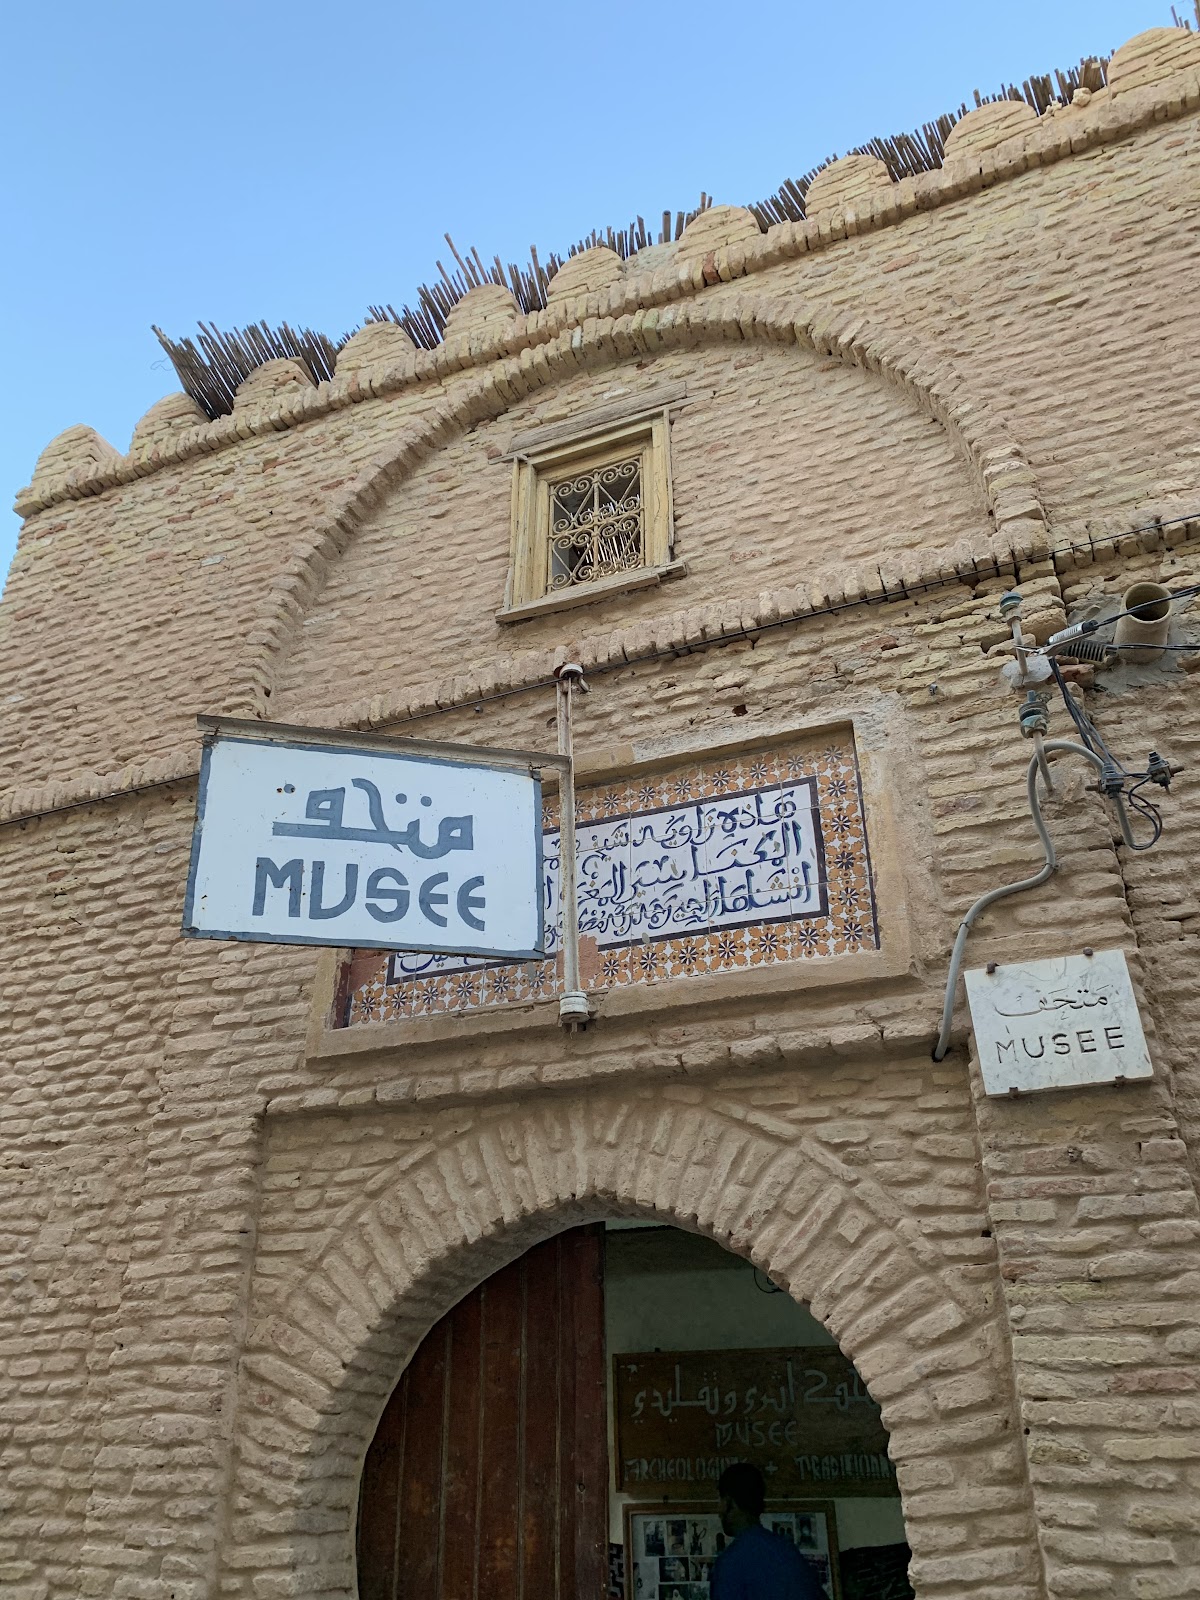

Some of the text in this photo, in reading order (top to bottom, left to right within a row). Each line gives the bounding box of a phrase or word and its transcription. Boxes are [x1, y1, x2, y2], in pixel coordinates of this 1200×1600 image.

[272, 778, 474, 859] متحف
[252, 857, 486, 931] MUSEE
[993, 986, 1110, 1019] متحف
[995, 1026, 1125, 1064] MUSEE
[715, 1420, 799, 1448] MUSEE
[624, 1457, 748, 1481] ARCHEOLOGI
